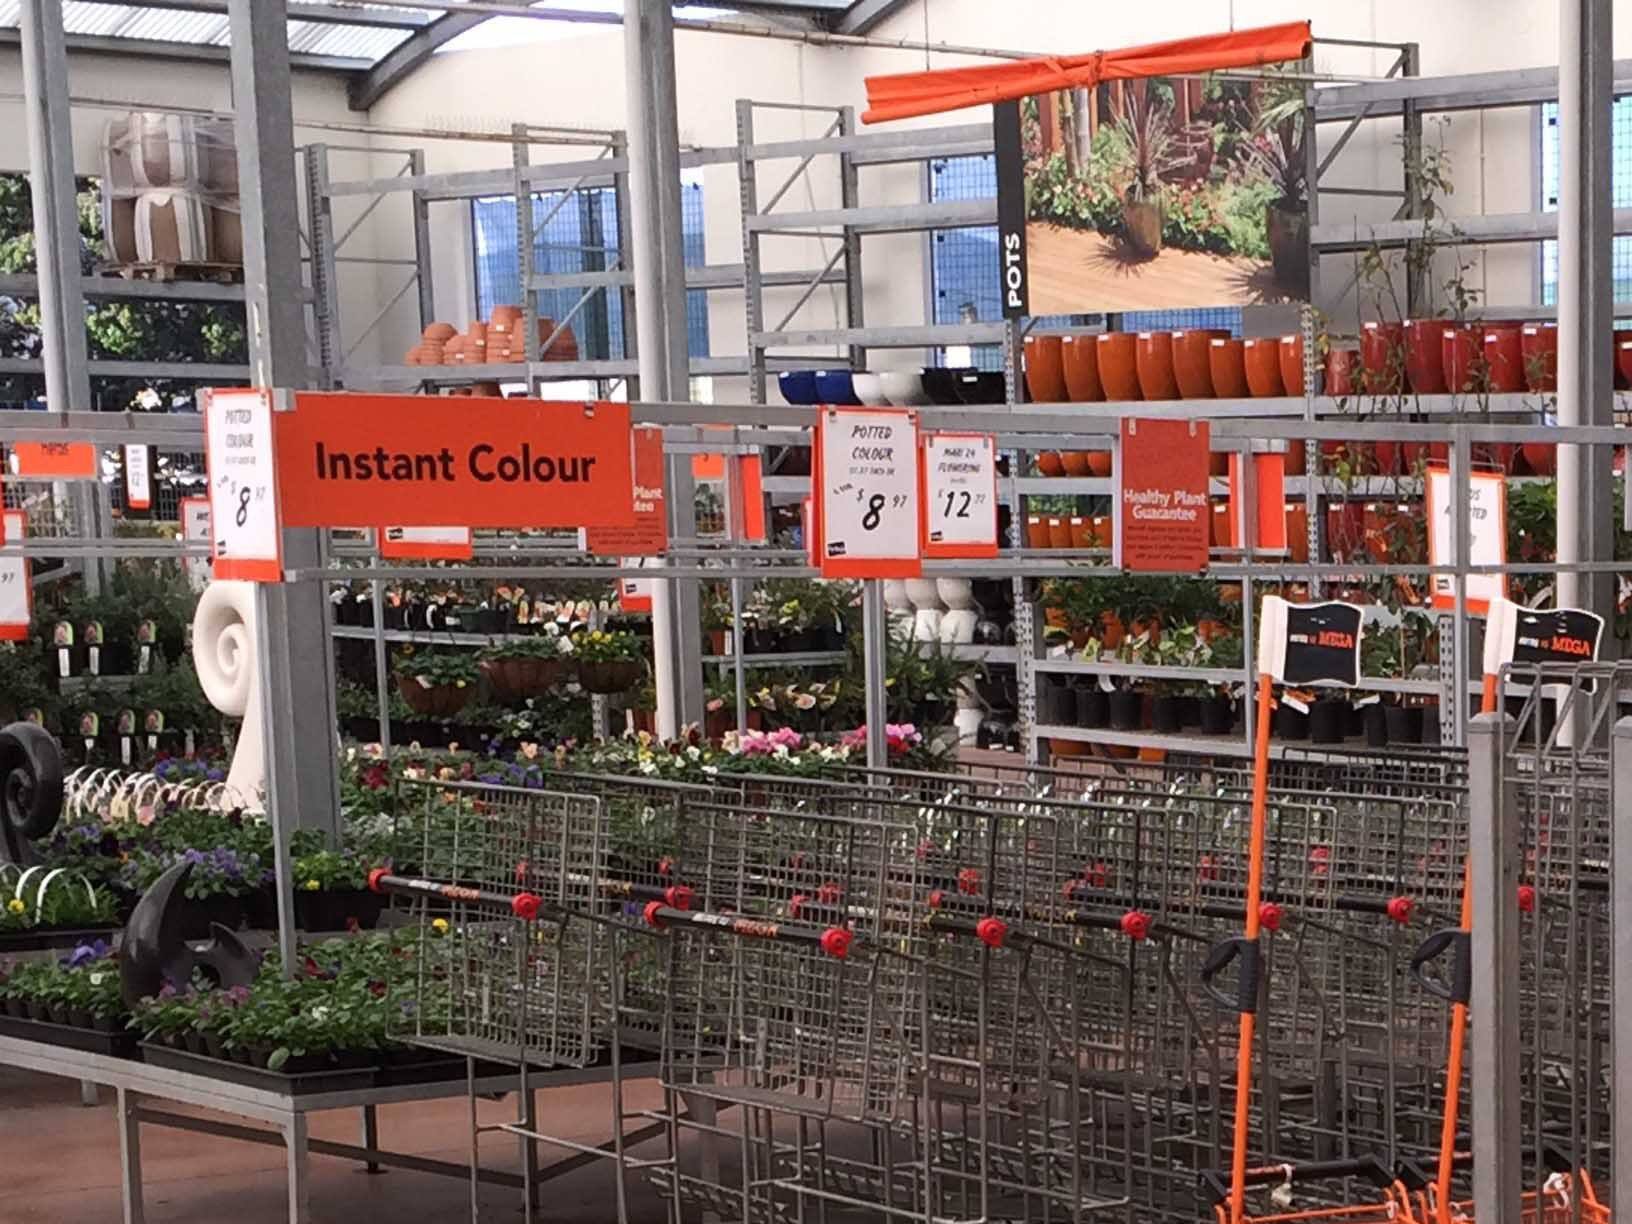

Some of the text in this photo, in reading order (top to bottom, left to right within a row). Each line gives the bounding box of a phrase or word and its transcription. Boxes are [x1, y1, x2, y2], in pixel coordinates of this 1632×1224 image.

[1004, 232, 1023, 307] POTS
[852, 425, 893, 439] POTTED
[316, 442, 596, 483] Instant Colour
[852, 447, 894, 462] COLOUR
[633, 486, 663, 499] Plant
[1123, 488, 1207, 507] Healthy Plant
[944, 491, 971, 518] 12
[1132, 504, 1197, 521] Guarantee
